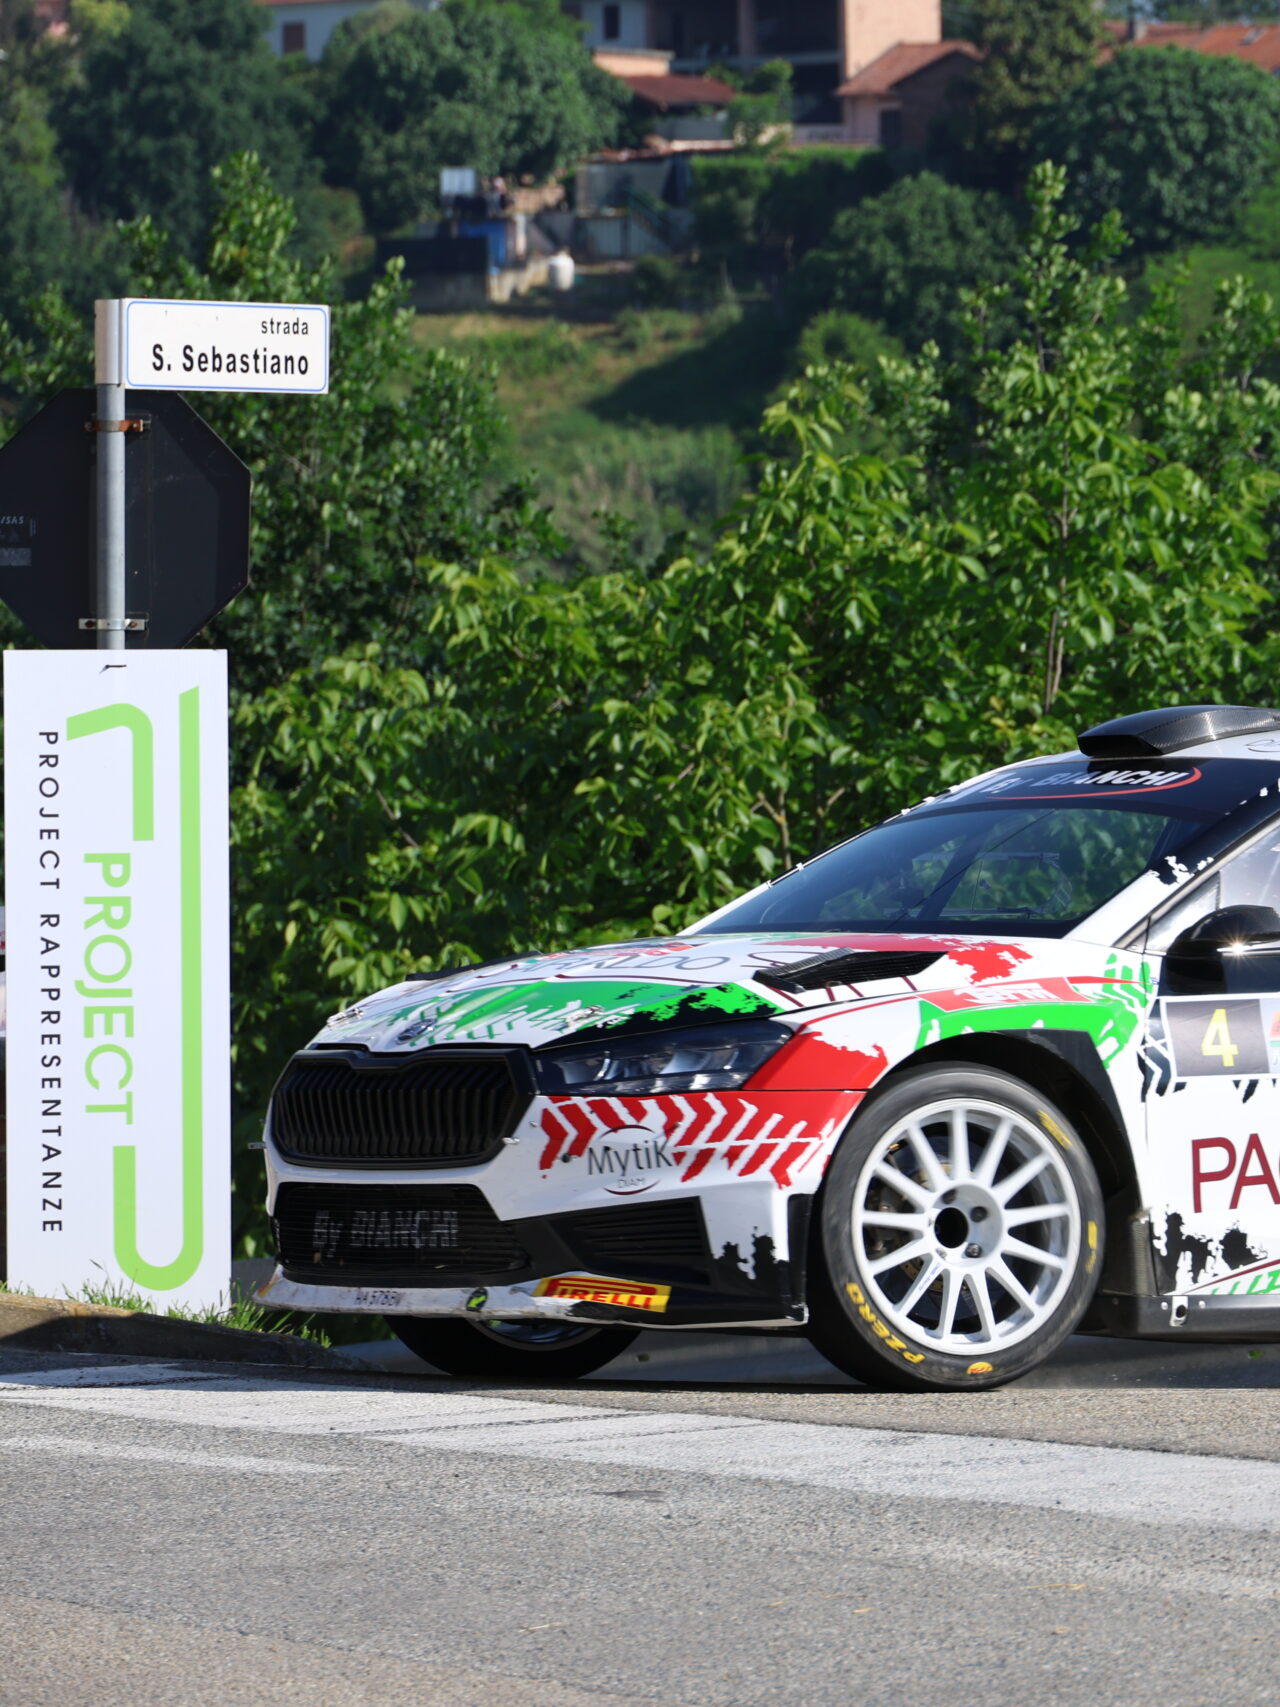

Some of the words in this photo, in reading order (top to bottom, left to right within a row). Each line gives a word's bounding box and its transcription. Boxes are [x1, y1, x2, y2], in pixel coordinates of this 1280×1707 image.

[261, 317, 309, 336] strada
[152, 343, 171, 372] S.
[182, 345, 309, 375] Sebastiano
[1030, 770, 1189, 787] BIANCHI
[38, 731, 60, 890] PROJECT
[74, 852, 133, 1126] PROJECT
[1201, 1008, 1239, 1067] 4
[40, 913, 63, 1232] RAPPRESENTANZE
[543, 1277, 657, 1309] PIRELLI
